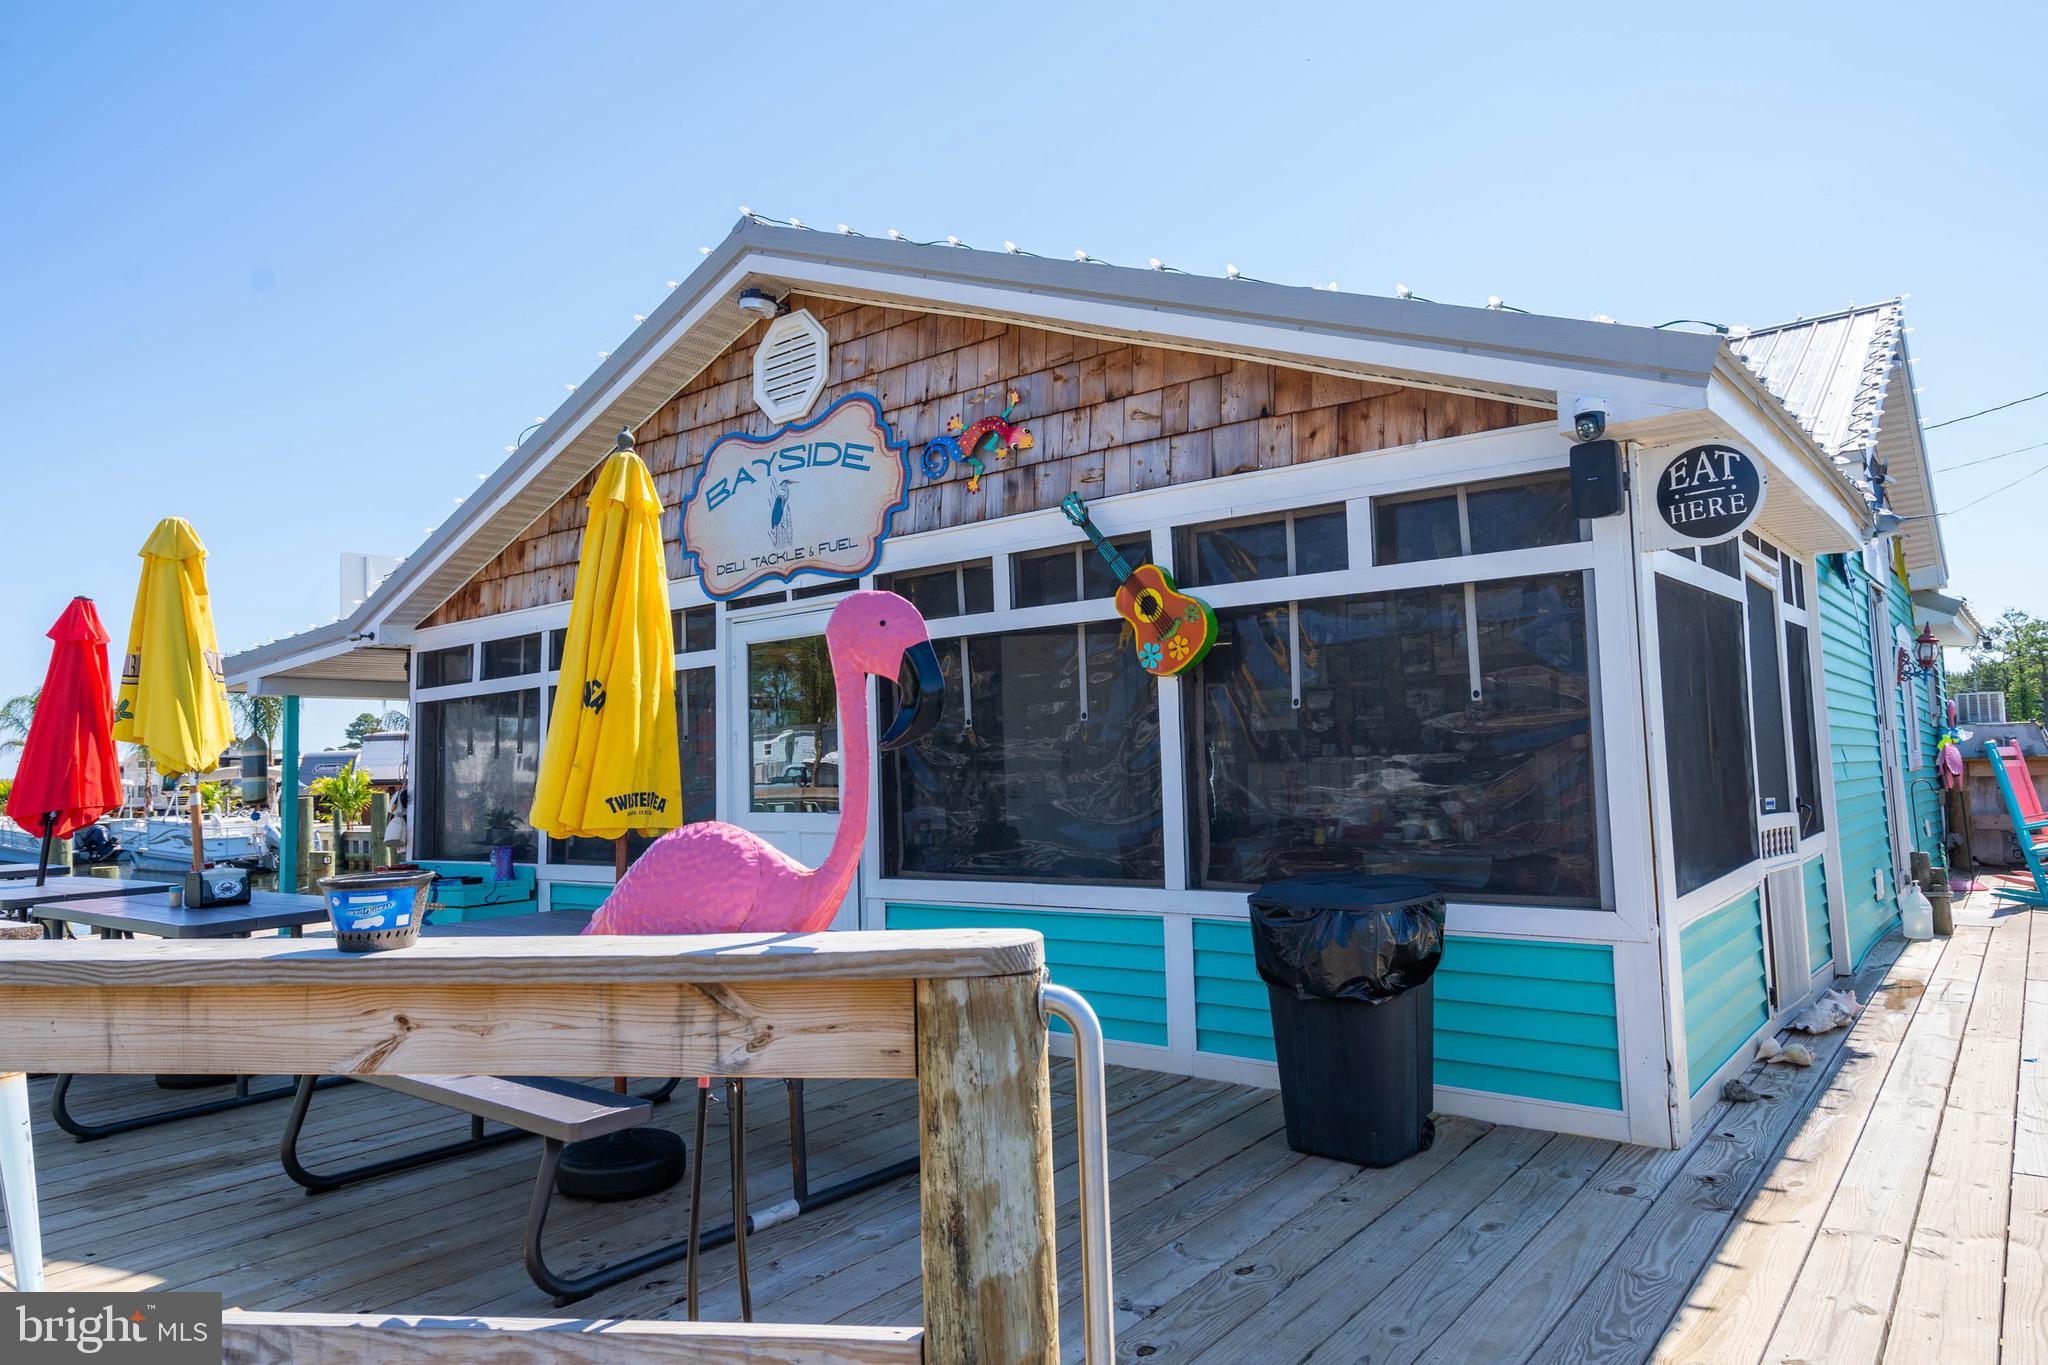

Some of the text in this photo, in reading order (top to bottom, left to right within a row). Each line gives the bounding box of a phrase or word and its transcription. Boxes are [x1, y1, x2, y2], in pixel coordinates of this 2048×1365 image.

[705, 442, 875, 512] BAYSIDE
[1668, 450, 1741, 491] EAT
[1668, 493, 1748, 525] HERE
[751, 547, 805, 569] TACKLE
[808, 545, 815, 557] &
[818, 537, 859, 555] FUEL
